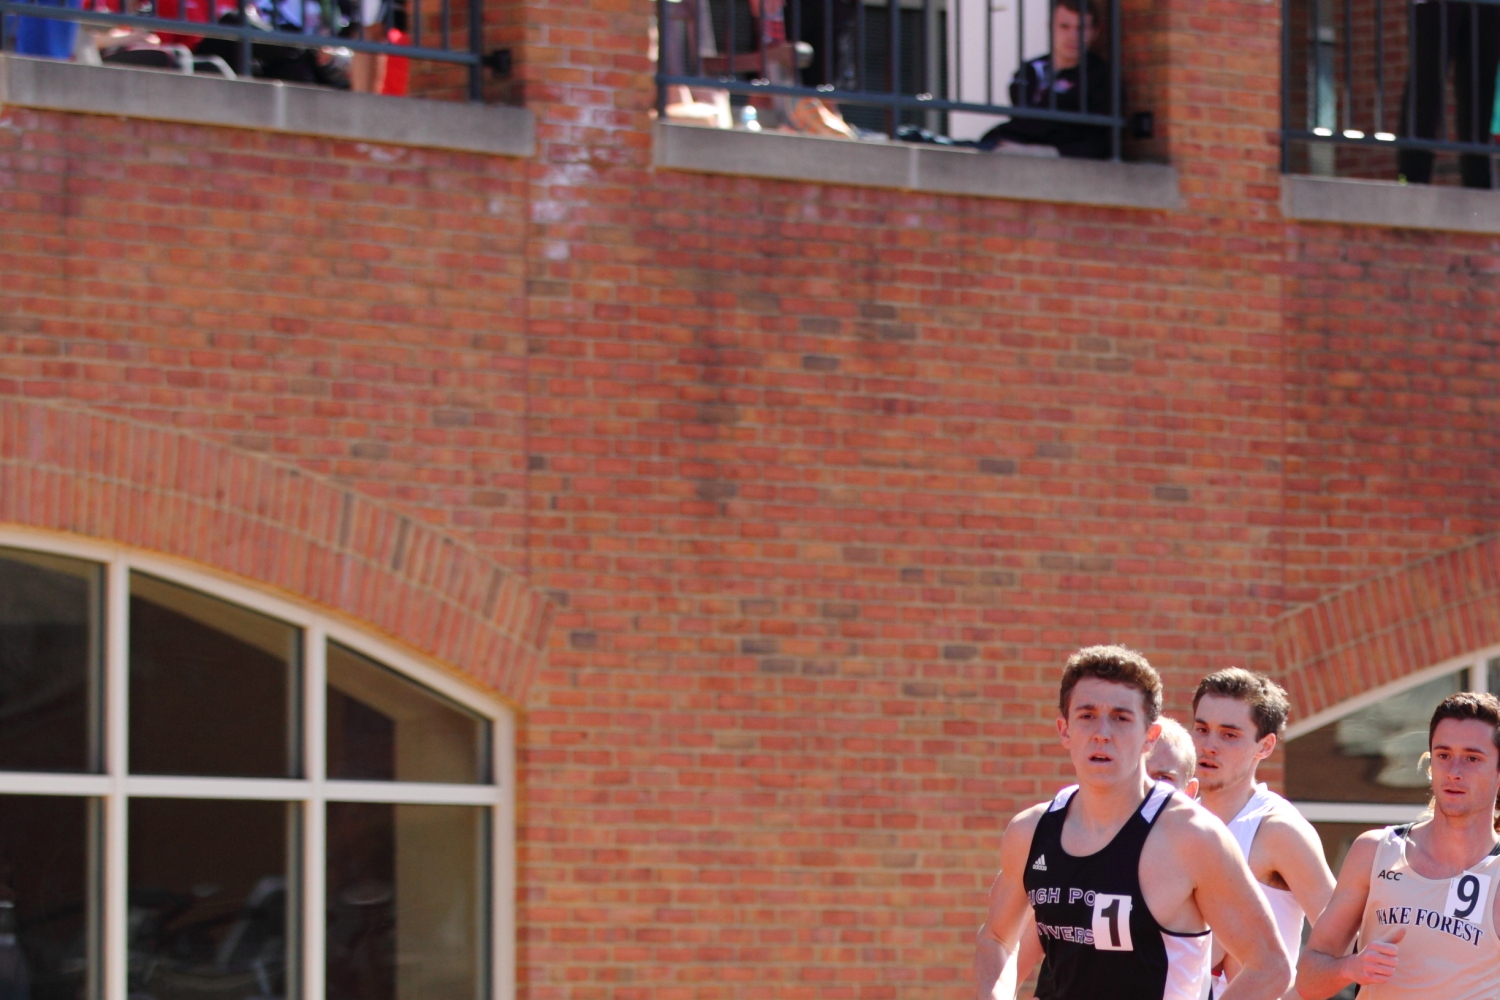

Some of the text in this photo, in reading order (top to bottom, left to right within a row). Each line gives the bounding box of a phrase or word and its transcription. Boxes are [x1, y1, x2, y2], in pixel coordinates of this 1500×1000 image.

[1377, 869, 1403, 882] ACC
[1453, 874, 1481, 919] 9
[1100, 898, 1122, 948] 1
[1415, 908, 1484, 947] FOREST
